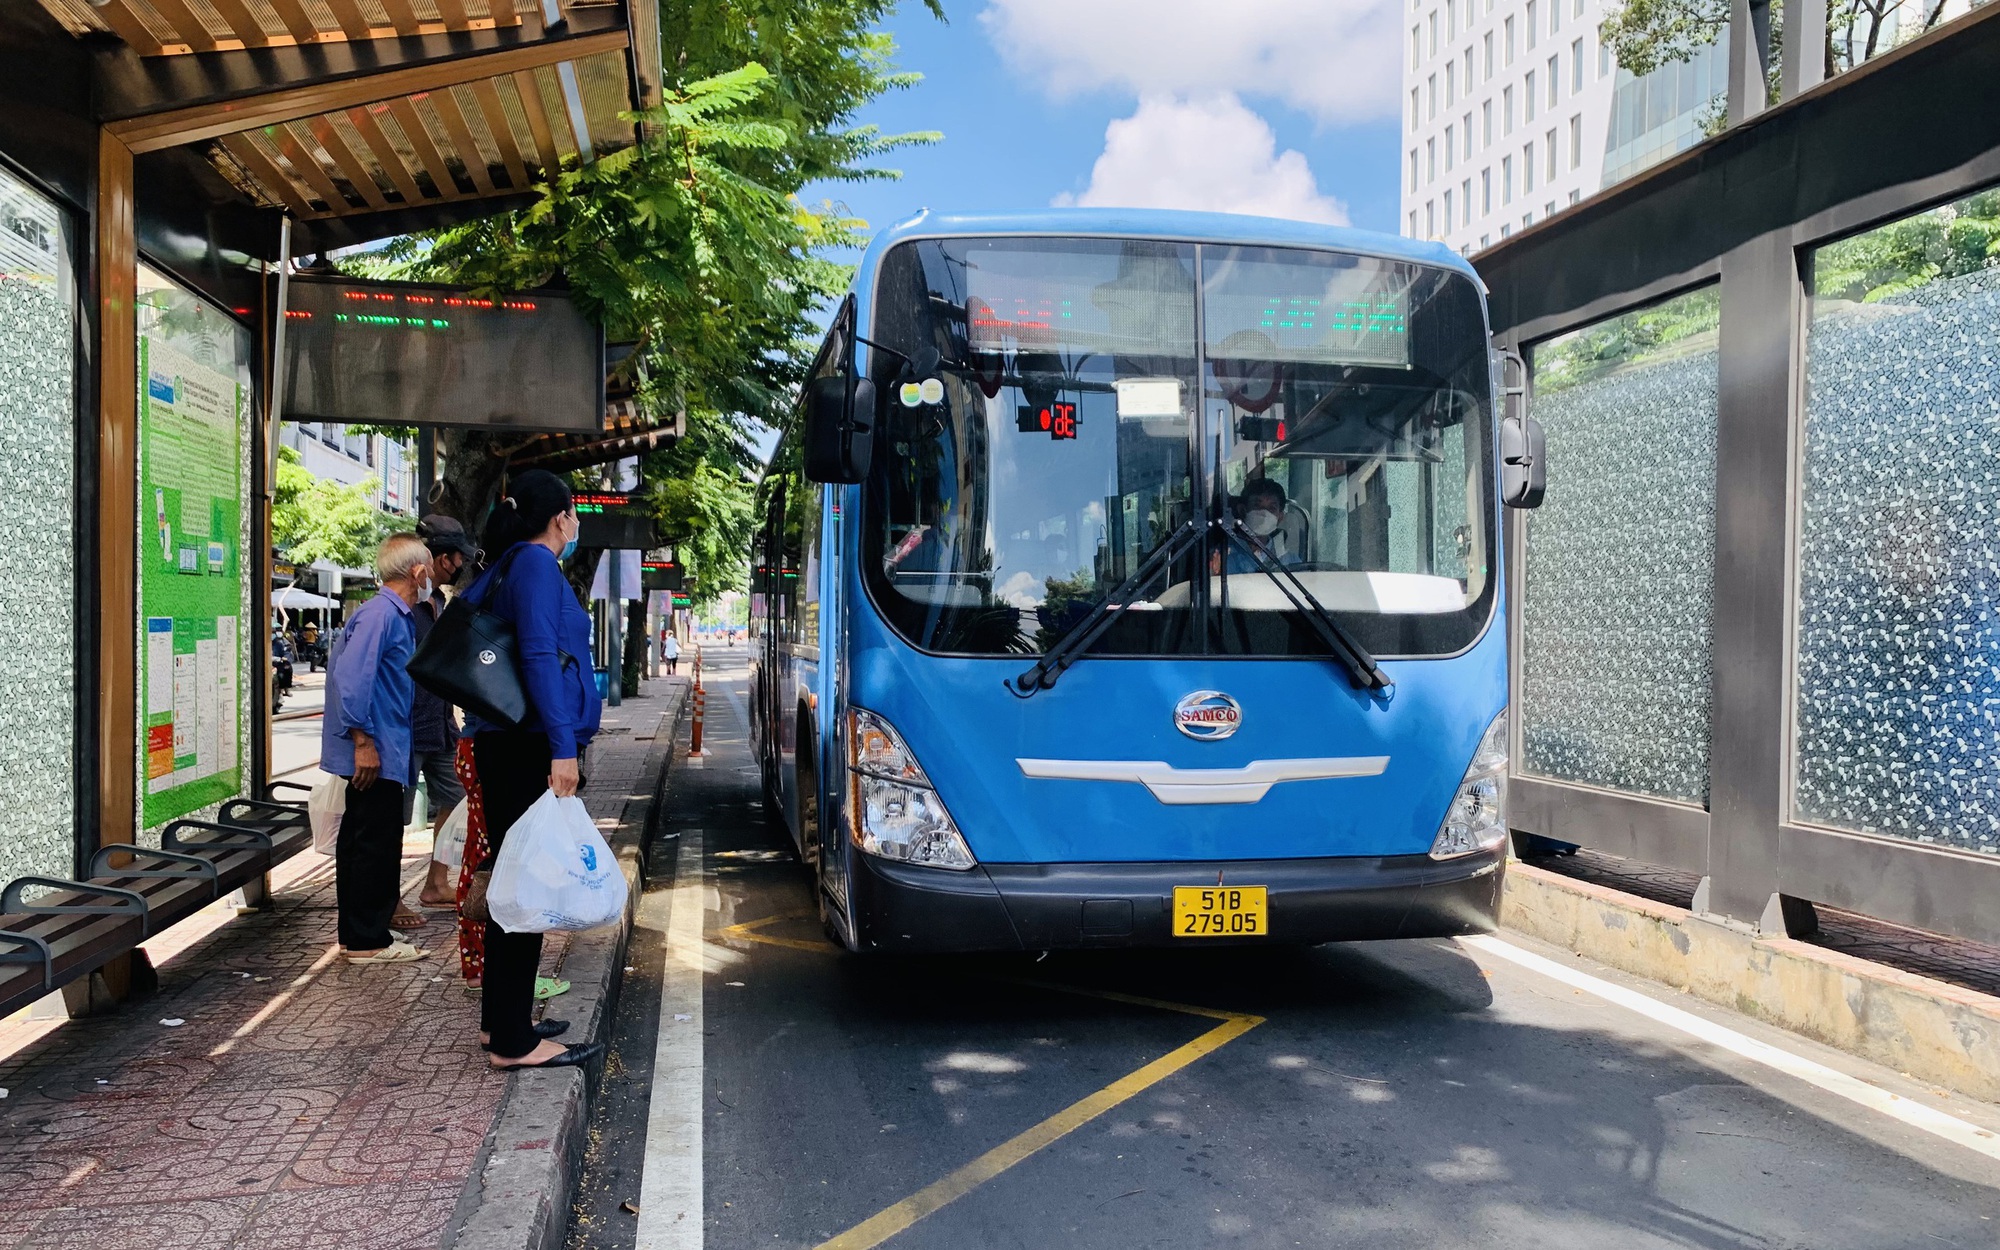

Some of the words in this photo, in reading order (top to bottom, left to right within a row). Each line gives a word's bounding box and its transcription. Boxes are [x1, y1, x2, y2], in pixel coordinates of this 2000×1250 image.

[1181, 708, 1238, 722] SAMCO
[1202, 890, 1241, 910] 51B
[1184, 913, 1257, 933] 279.05
